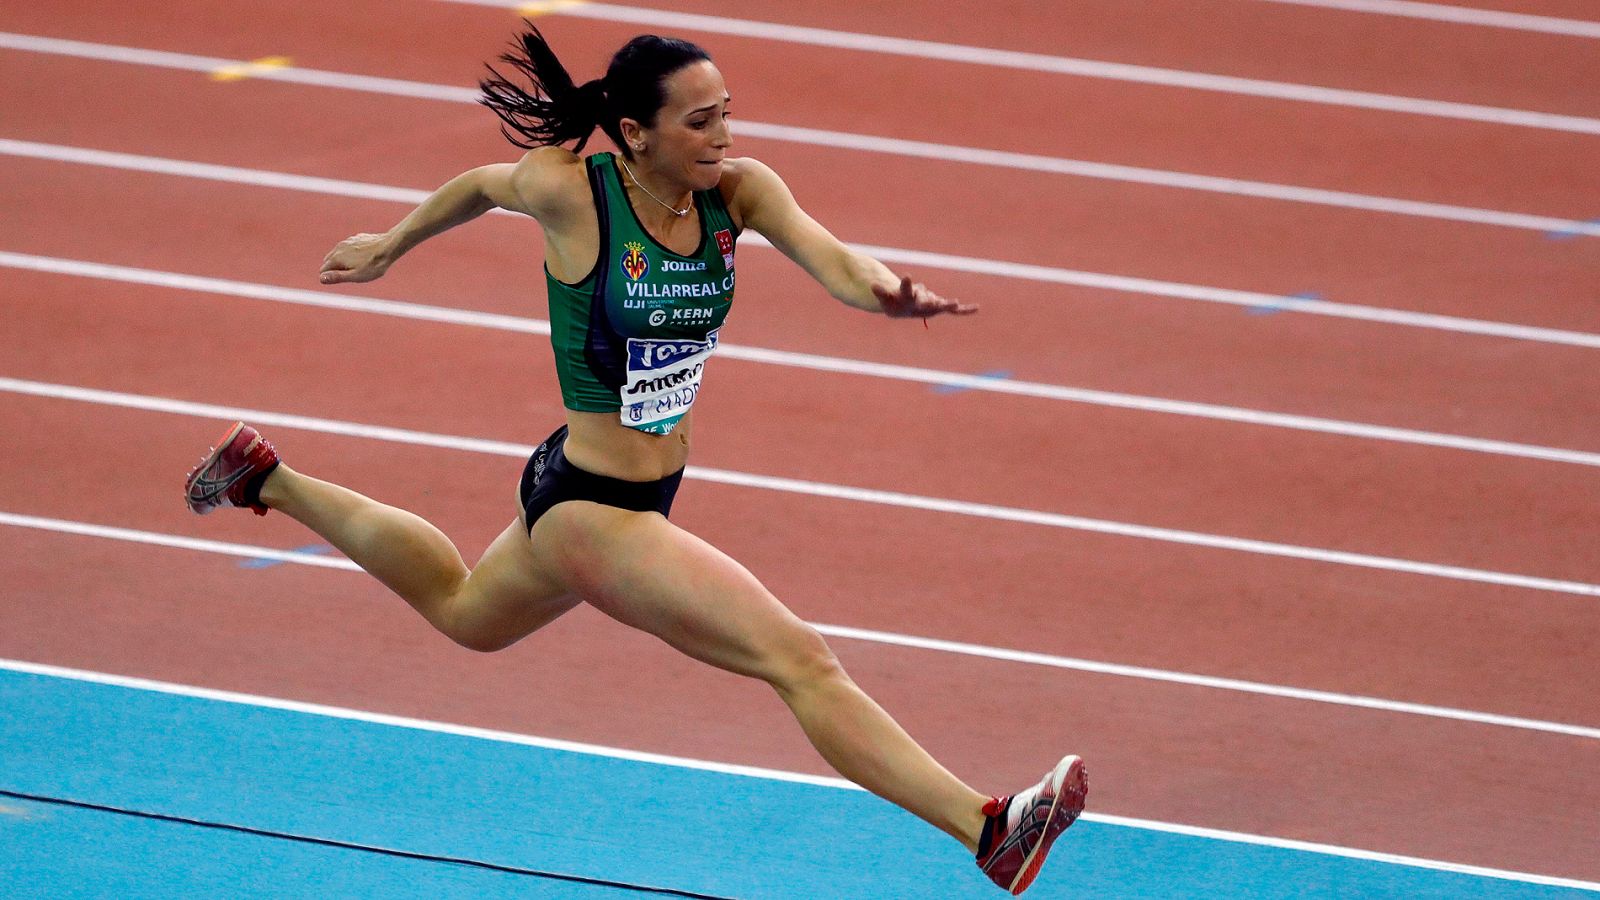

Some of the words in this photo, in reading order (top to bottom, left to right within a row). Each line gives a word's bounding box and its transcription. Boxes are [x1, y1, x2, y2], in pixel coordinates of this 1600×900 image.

[661, 260, 707, 272] Joma
[626, 282, 720, 297] VILLARREAL
[623, 300, 645, 309] UJI
[672, 307, 713, 319] KERN
